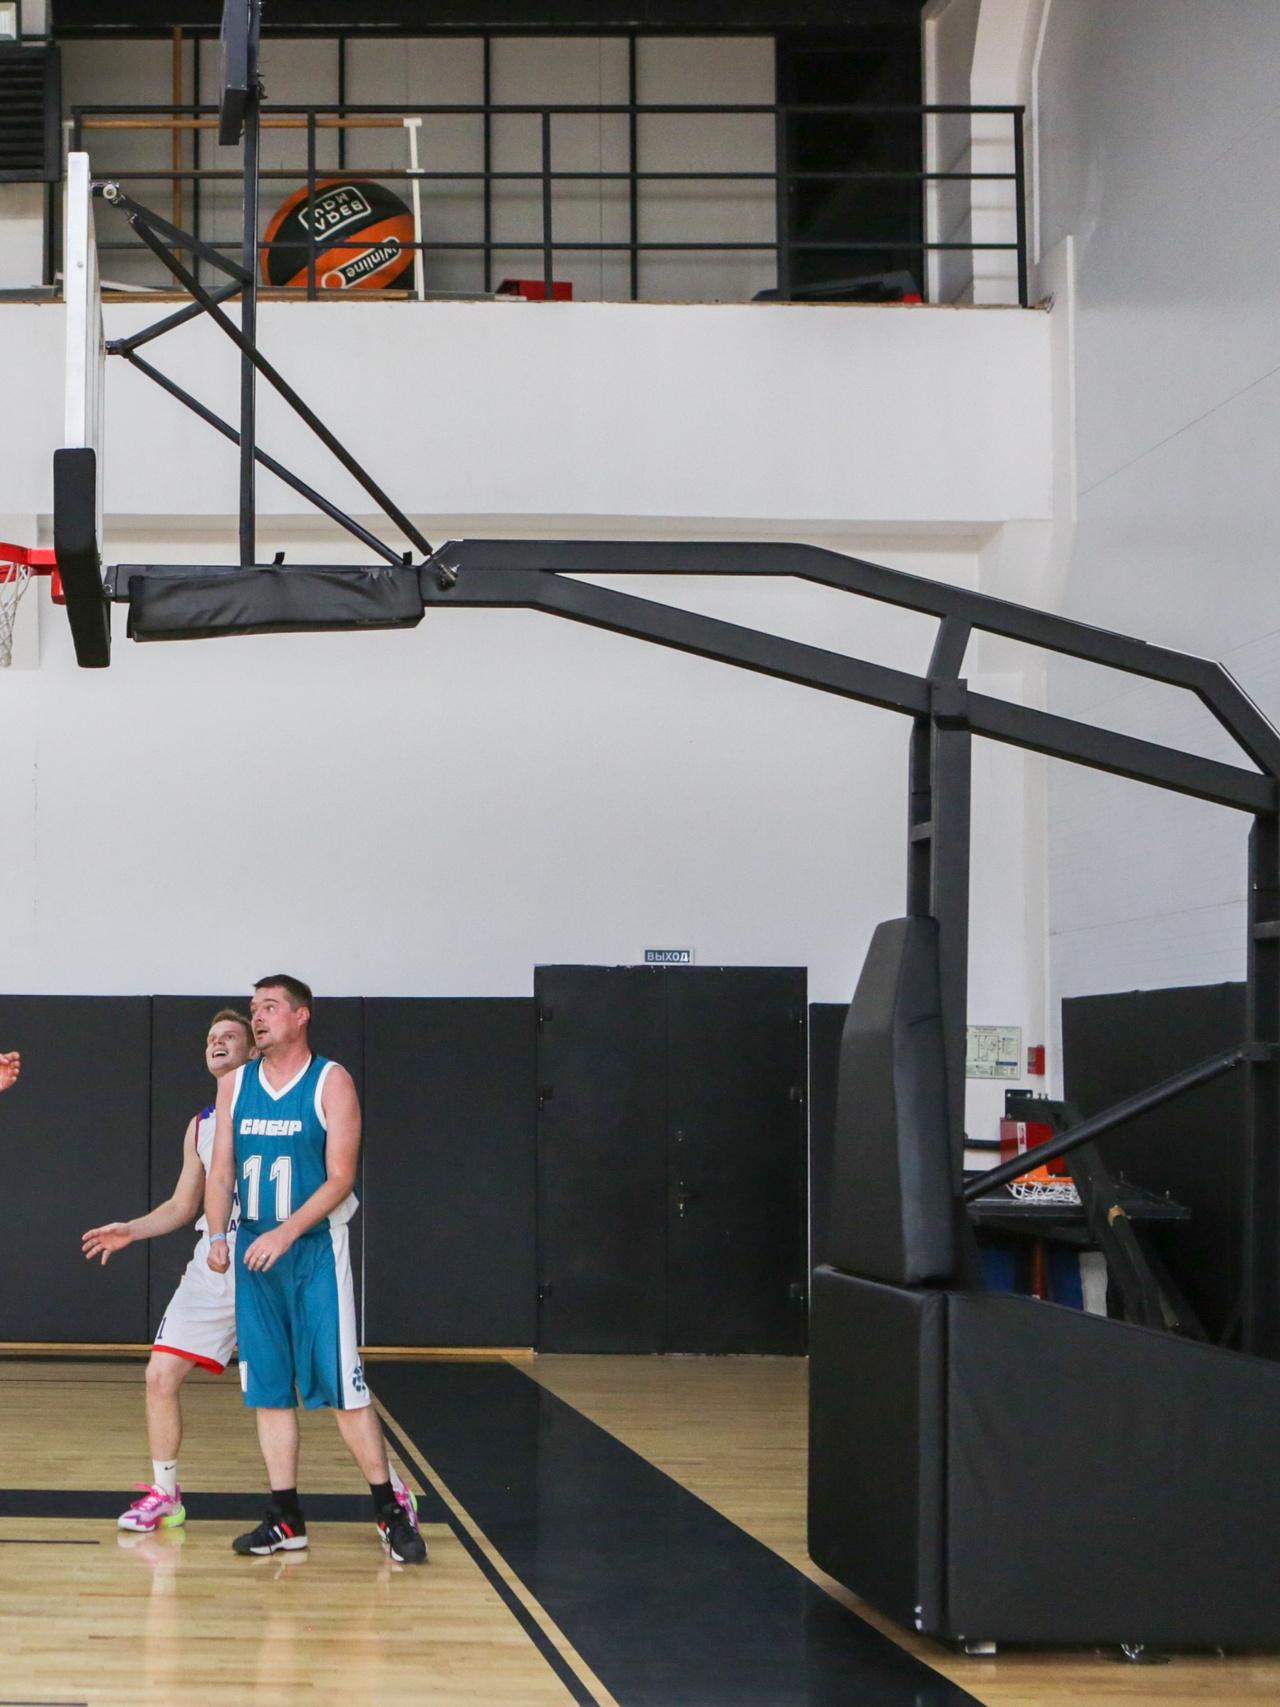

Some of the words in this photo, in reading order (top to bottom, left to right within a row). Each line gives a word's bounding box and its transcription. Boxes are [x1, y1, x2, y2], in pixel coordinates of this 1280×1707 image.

[647, 952, 689, 962] ВЫХОД
[240, 1118, 302, 1136] СИБУР
[243, 1155, 292, 1221] 11
